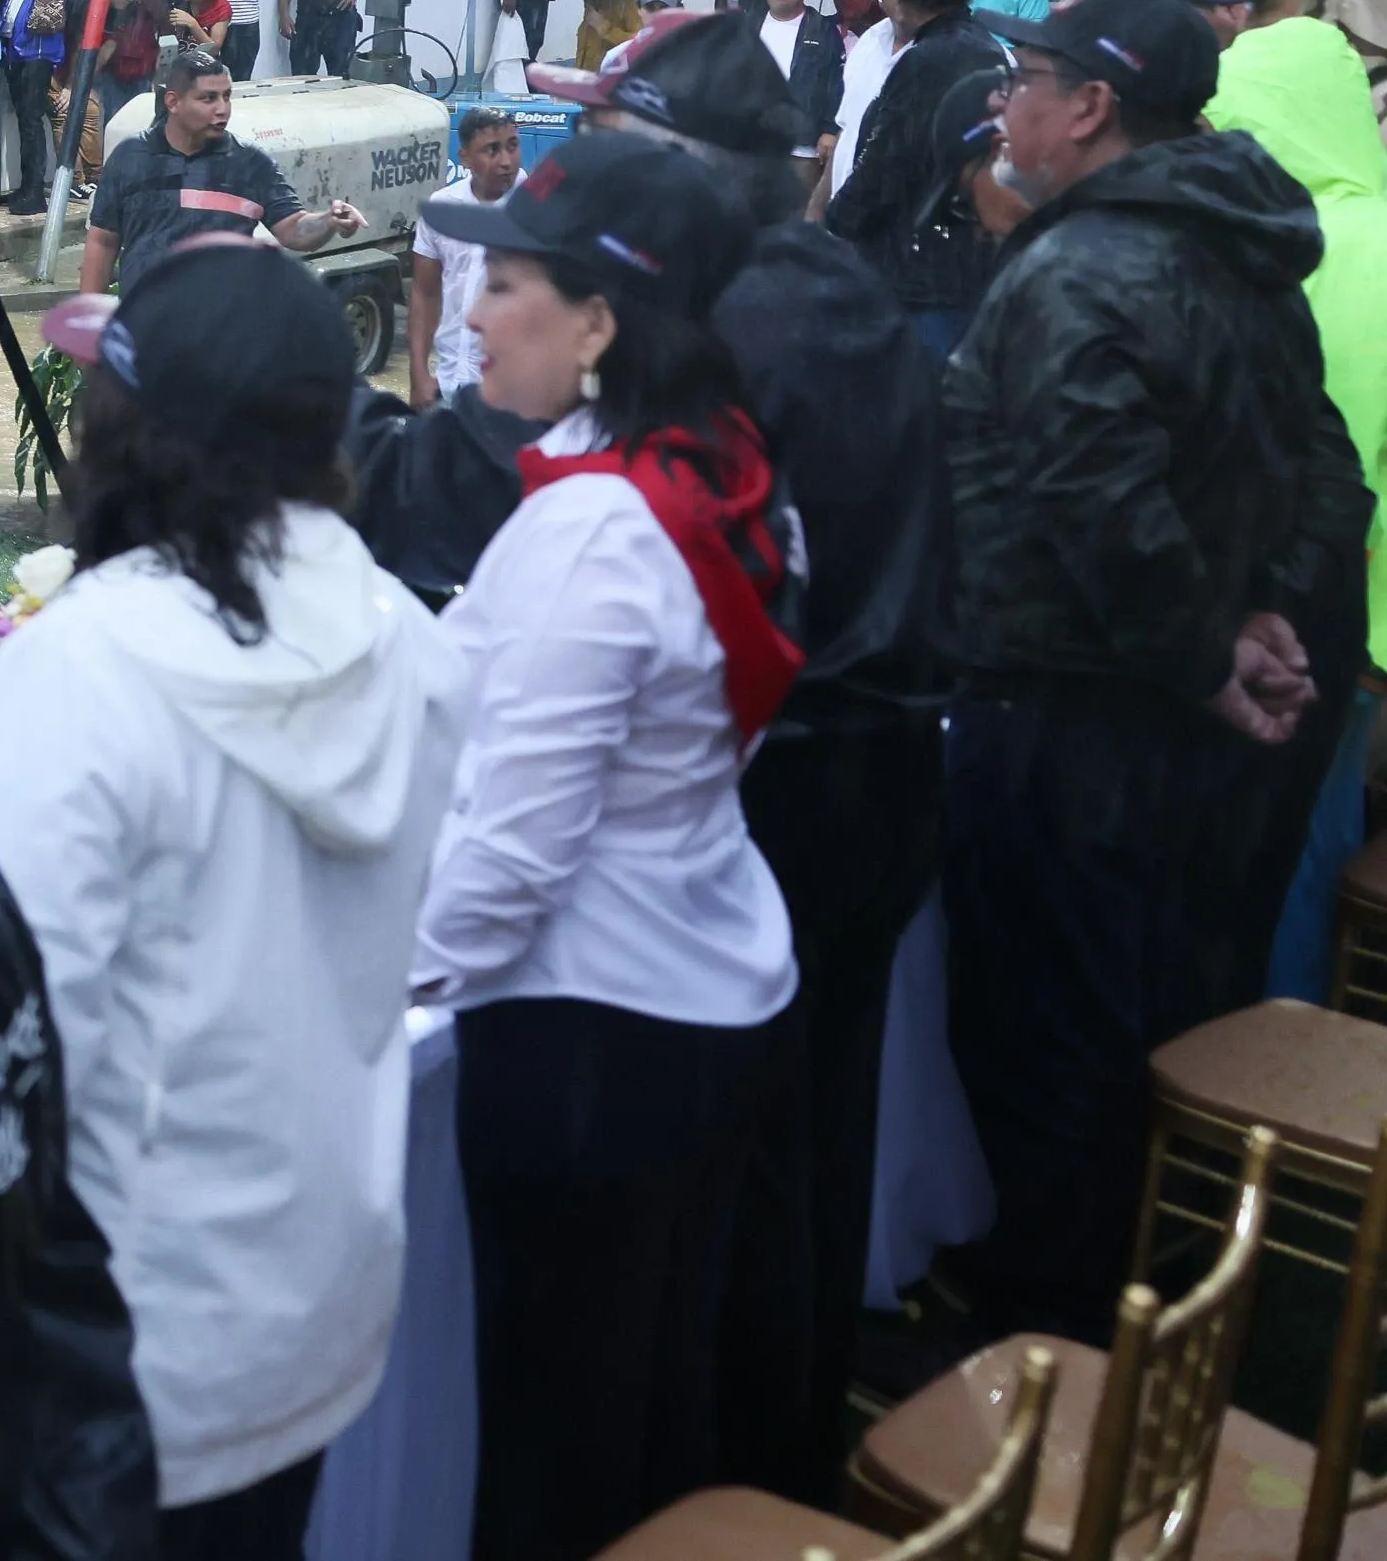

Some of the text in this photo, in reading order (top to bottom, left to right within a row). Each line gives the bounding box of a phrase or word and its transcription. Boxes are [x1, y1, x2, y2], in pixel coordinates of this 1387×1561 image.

[514, 111, 567, 124] Bobcat
[370, 141, 441, 170] WACKER
[370, 161, 440, 192] NEUSON
